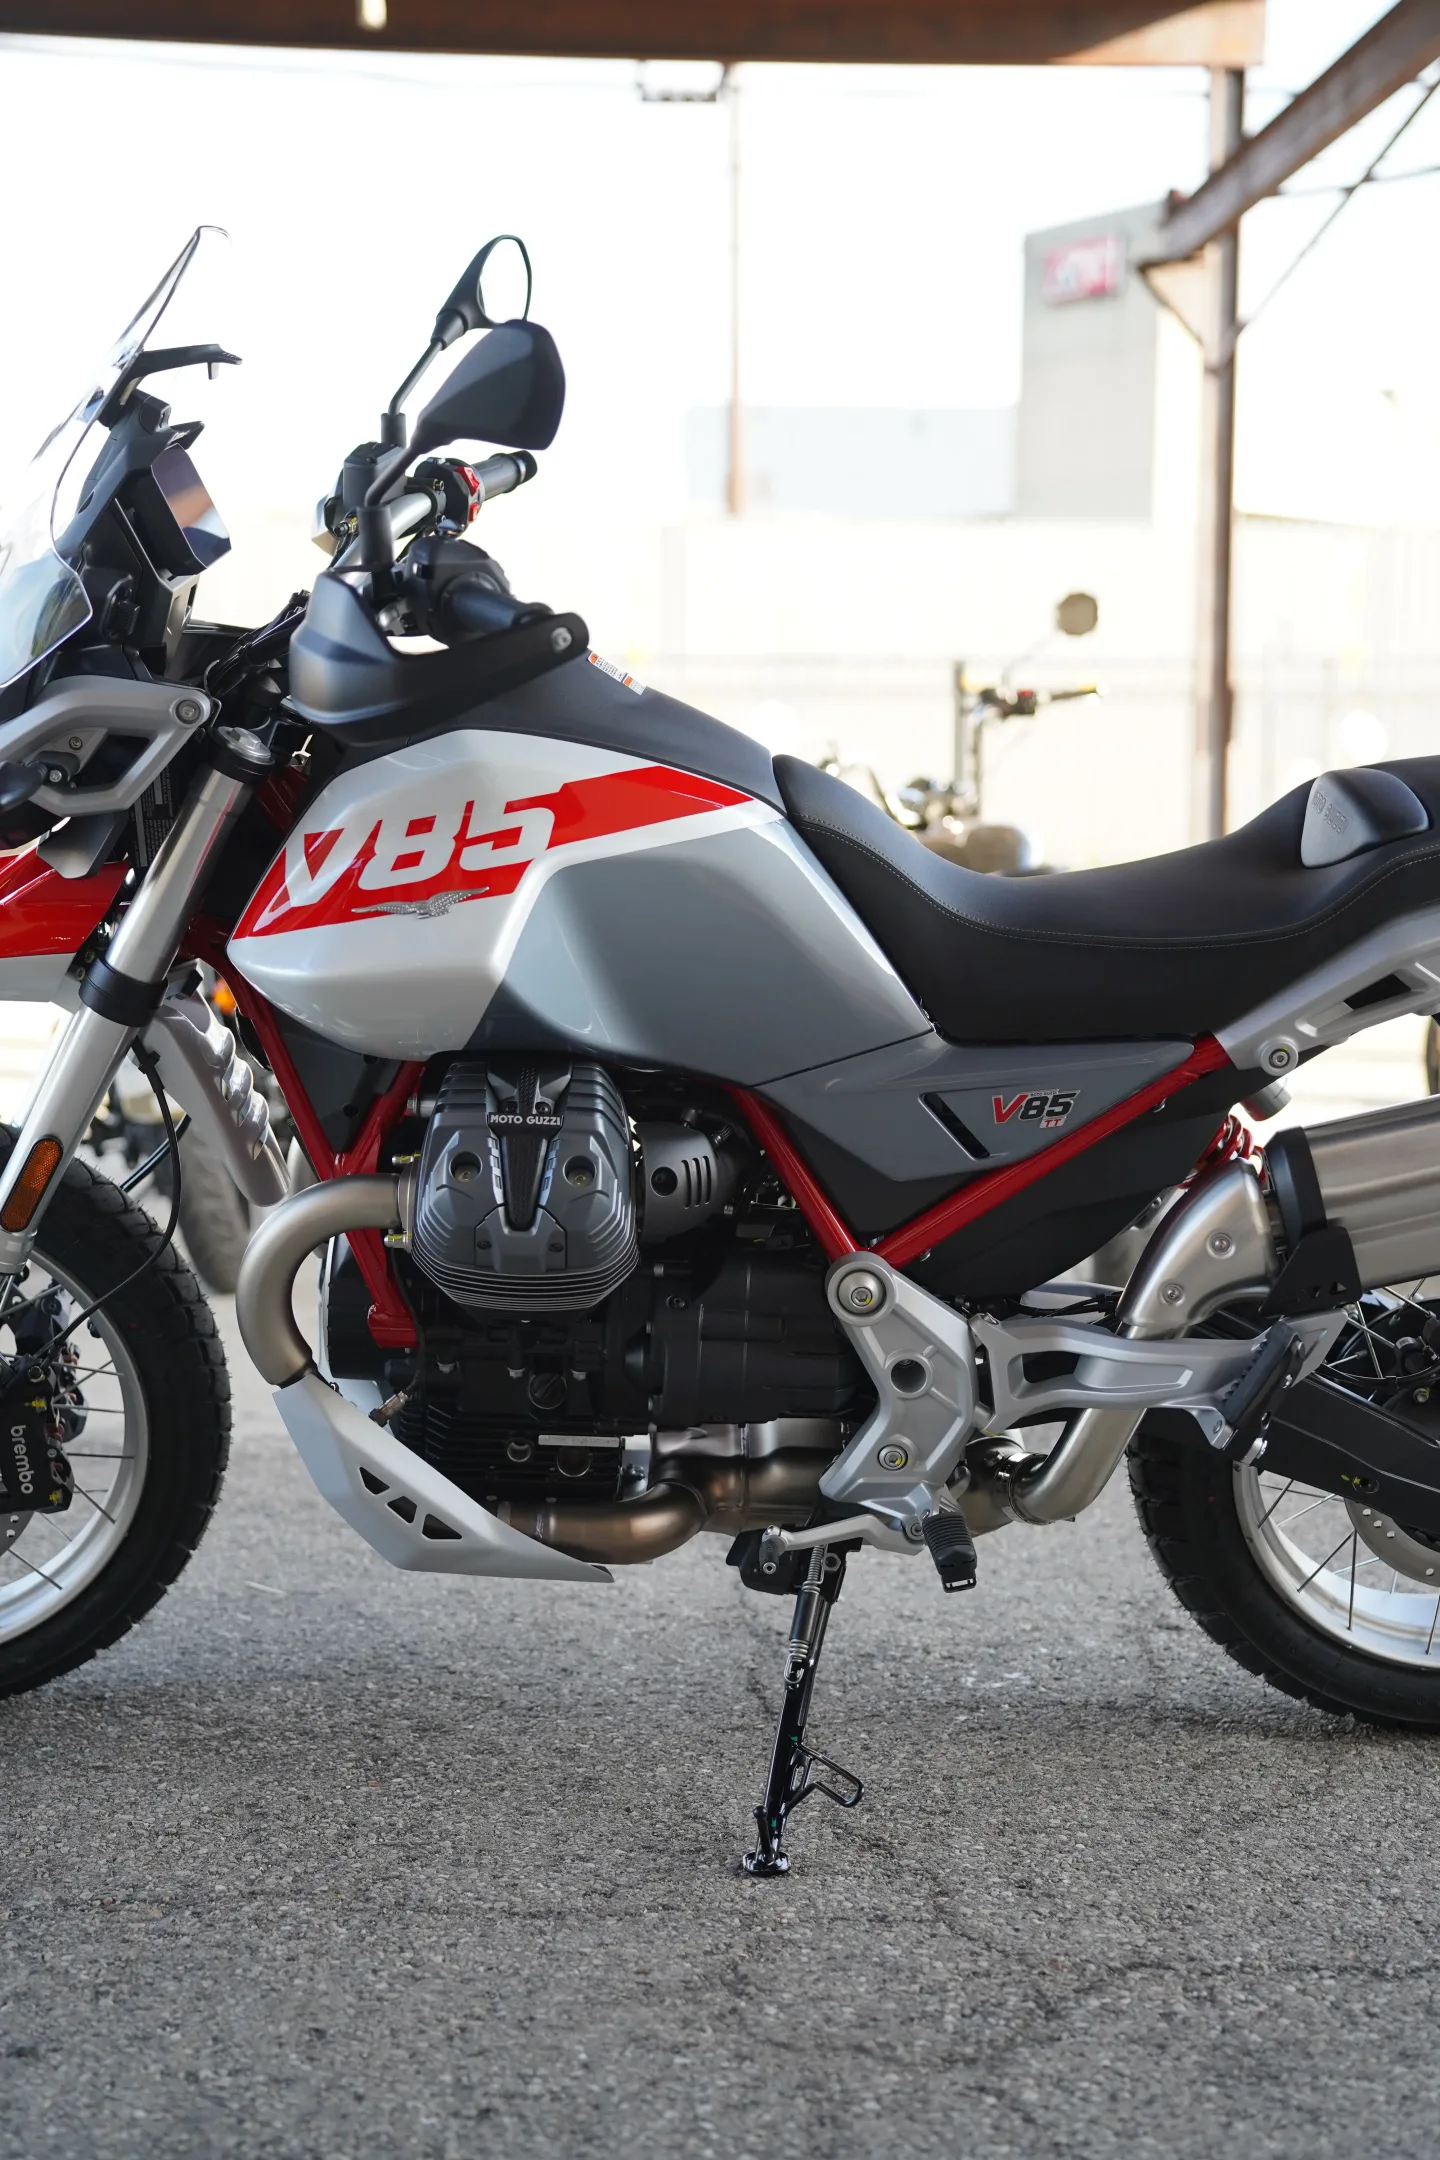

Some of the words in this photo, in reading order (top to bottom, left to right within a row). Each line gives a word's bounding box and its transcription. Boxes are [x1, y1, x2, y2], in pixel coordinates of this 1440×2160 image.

[284, 803, 556, 908] V85
[490, 1114, 523, 1124] MOTO
[526, 1116, 561, 1126] GUZZI
[992, 1090, 1080, 1124] V85
[1044, 1118, 1062, 1128] TT
[10, 1424, 35, 1494] brembo
